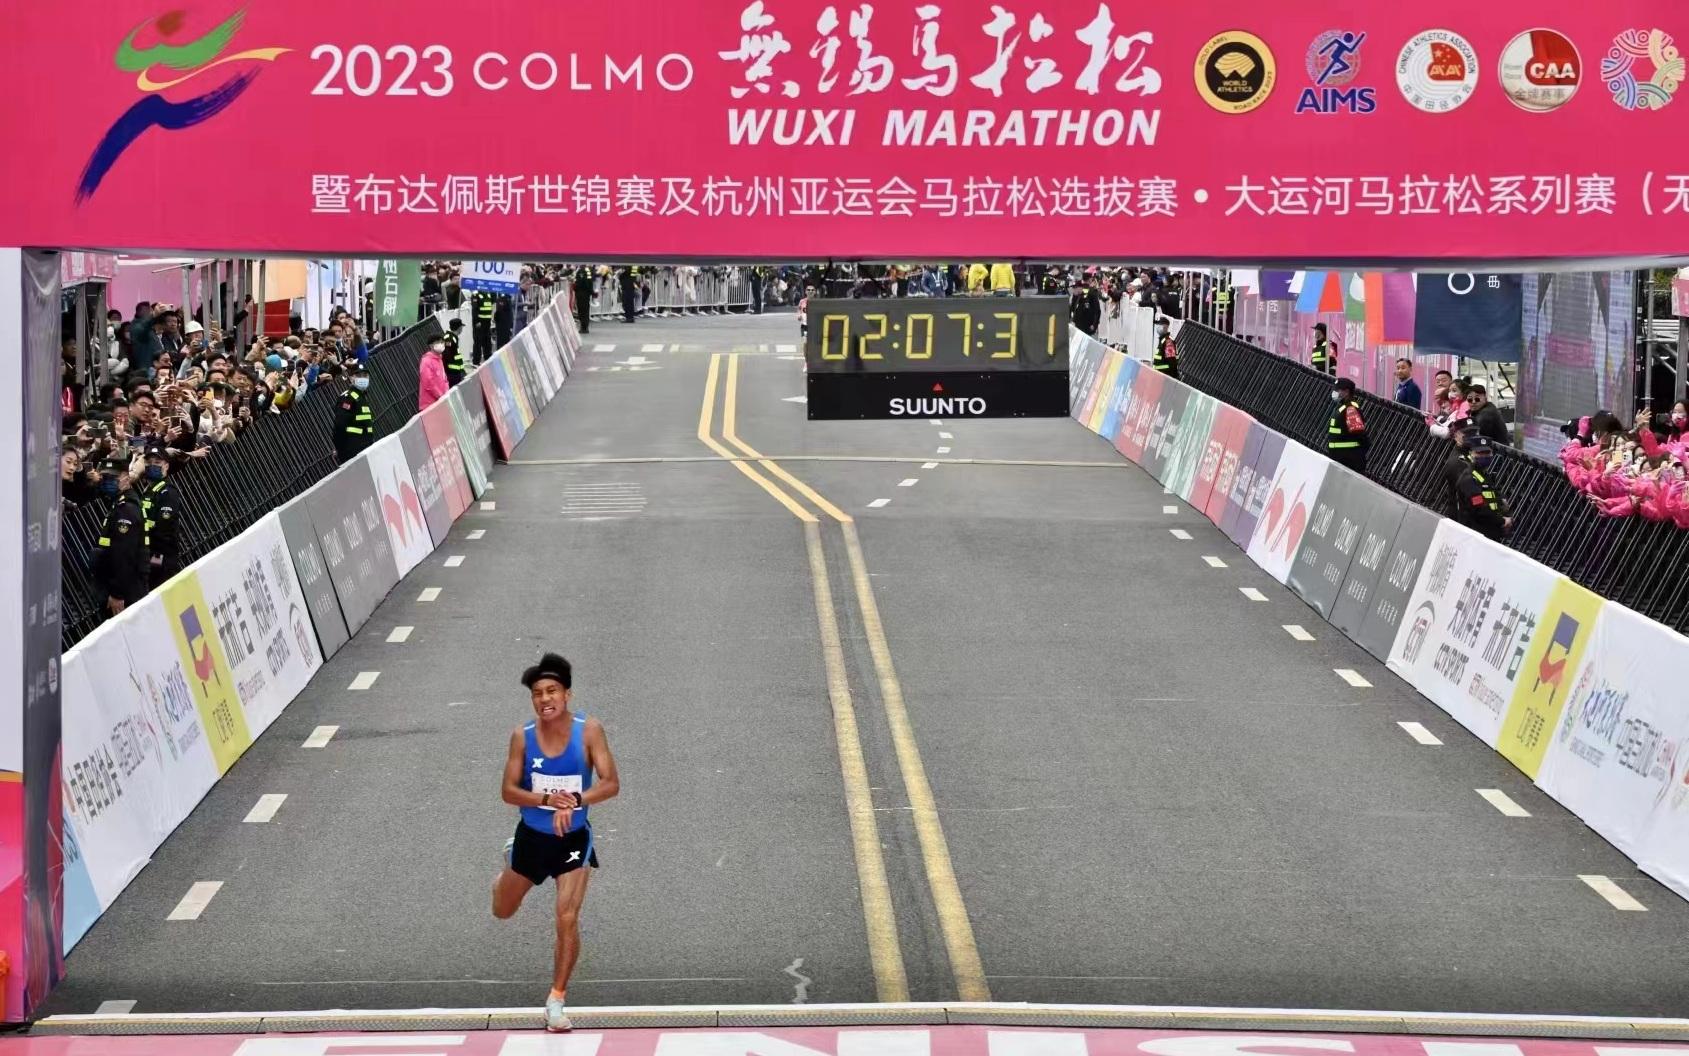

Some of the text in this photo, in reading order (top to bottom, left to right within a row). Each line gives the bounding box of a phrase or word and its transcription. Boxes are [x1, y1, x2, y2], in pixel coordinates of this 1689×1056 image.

[310, 44, 695, 97] 2023 COLMO
[1529, 62, 1577, 80] CAA
[1295, 88, 1376, 114] AIMS
[727, 108, 1161, 147] WUXI MARATHON
[820, 313, 1057, 360] 02:07:31
[889, 397, 987, 416] SUUNTO
[212, 588, 255, 671] 未来广告
[1482, 596, 1536, 681] 未来广告
